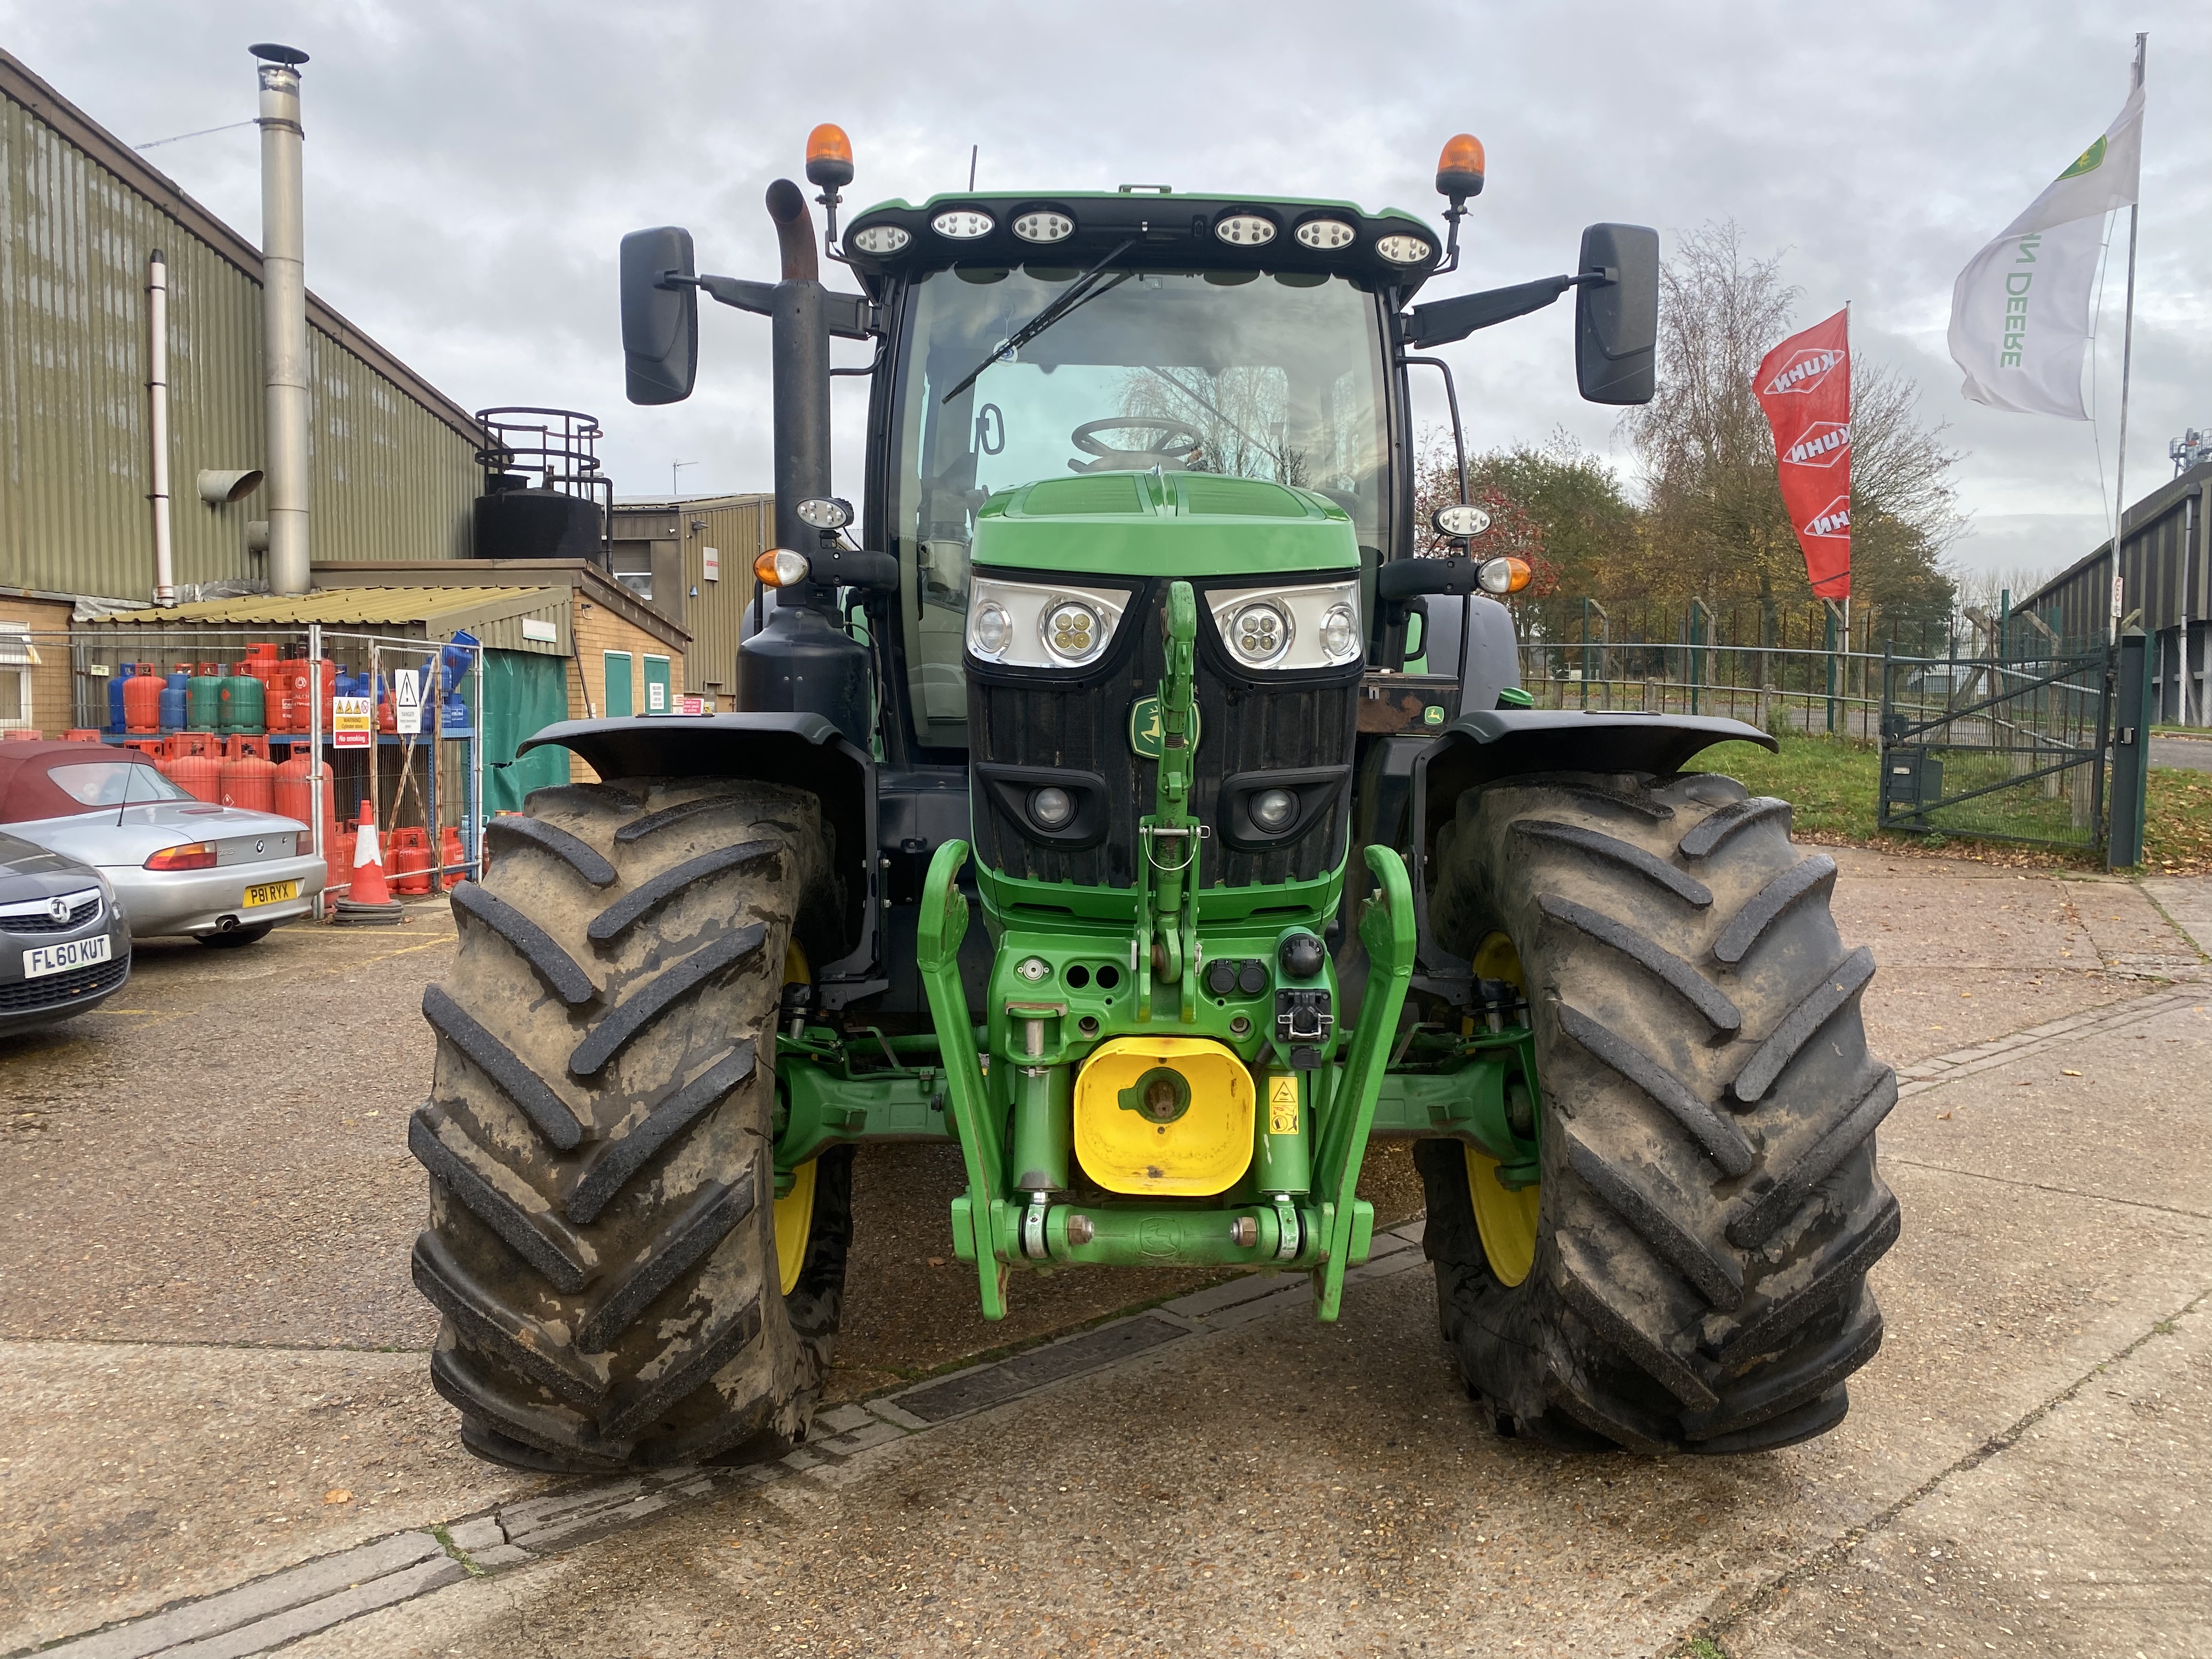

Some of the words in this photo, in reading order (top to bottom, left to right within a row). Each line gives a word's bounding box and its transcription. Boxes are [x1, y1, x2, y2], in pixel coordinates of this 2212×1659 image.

[346, 735, 365, 743] smoking
[270, 883, 289, 901] RYX
[32, 944, 77, 972] FL60
[80, 938, 104, 961] KUT
